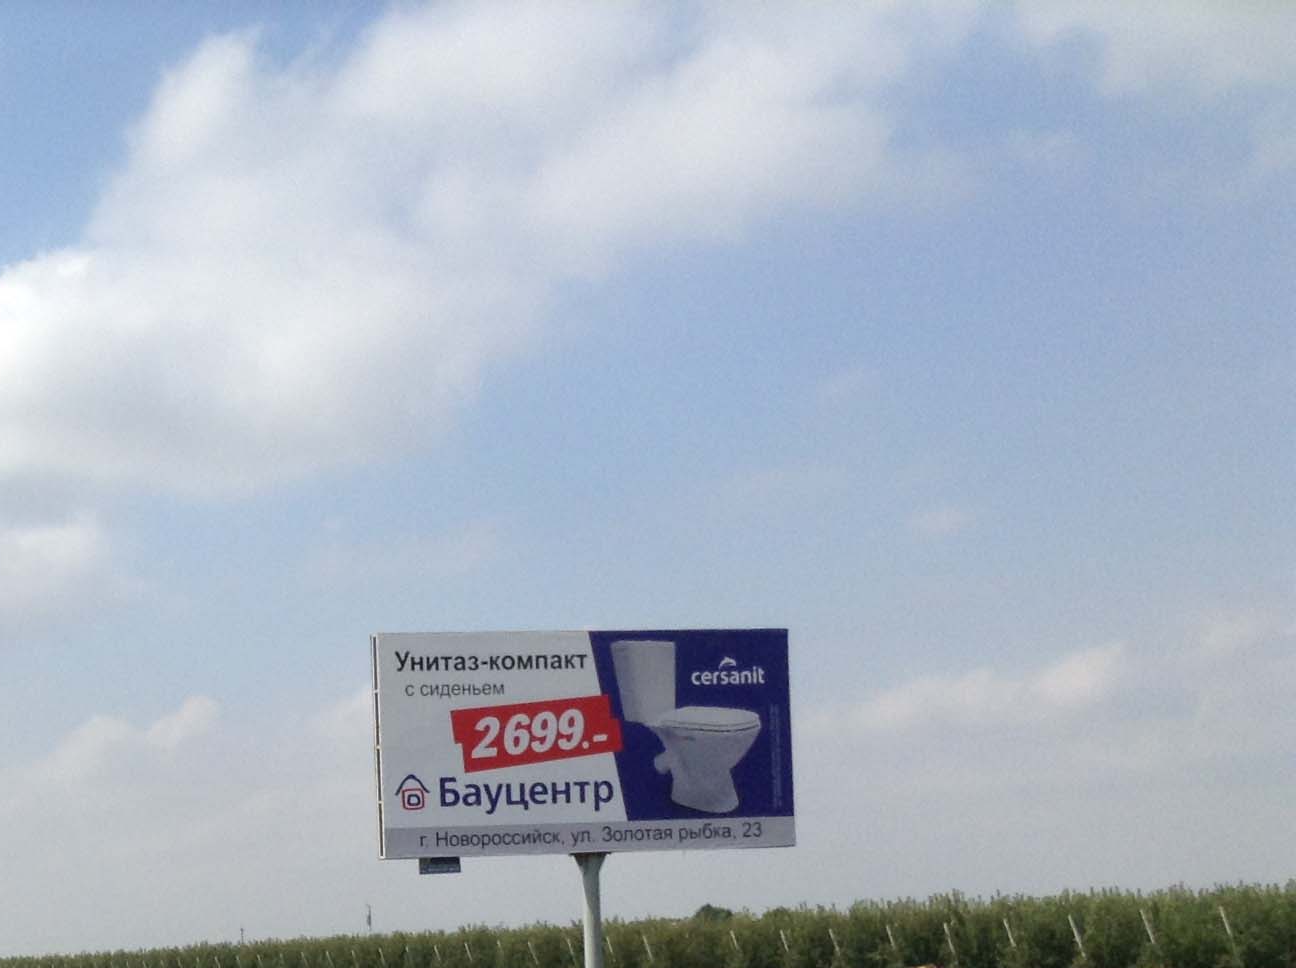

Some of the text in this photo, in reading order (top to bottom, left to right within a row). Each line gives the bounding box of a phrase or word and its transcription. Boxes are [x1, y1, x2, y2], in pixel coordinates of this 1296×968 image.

[394, 651, 588, 672] Унитаз-компакт
[690, 665, 765, 686] cersanit
[405, 682, 505, 698] с сиденьем
[471, 708, 608, 759] 2699.-
[439, 776, 614, 814] Бауцентр
[435, 828, 565, 849] Новороссийск,
[571, 831, 594, 847] ул.
[601, 826, 673, 842] Золотая
[678, 823, 737, 842] рыбка,
[742, 822, 762, 838] 23
